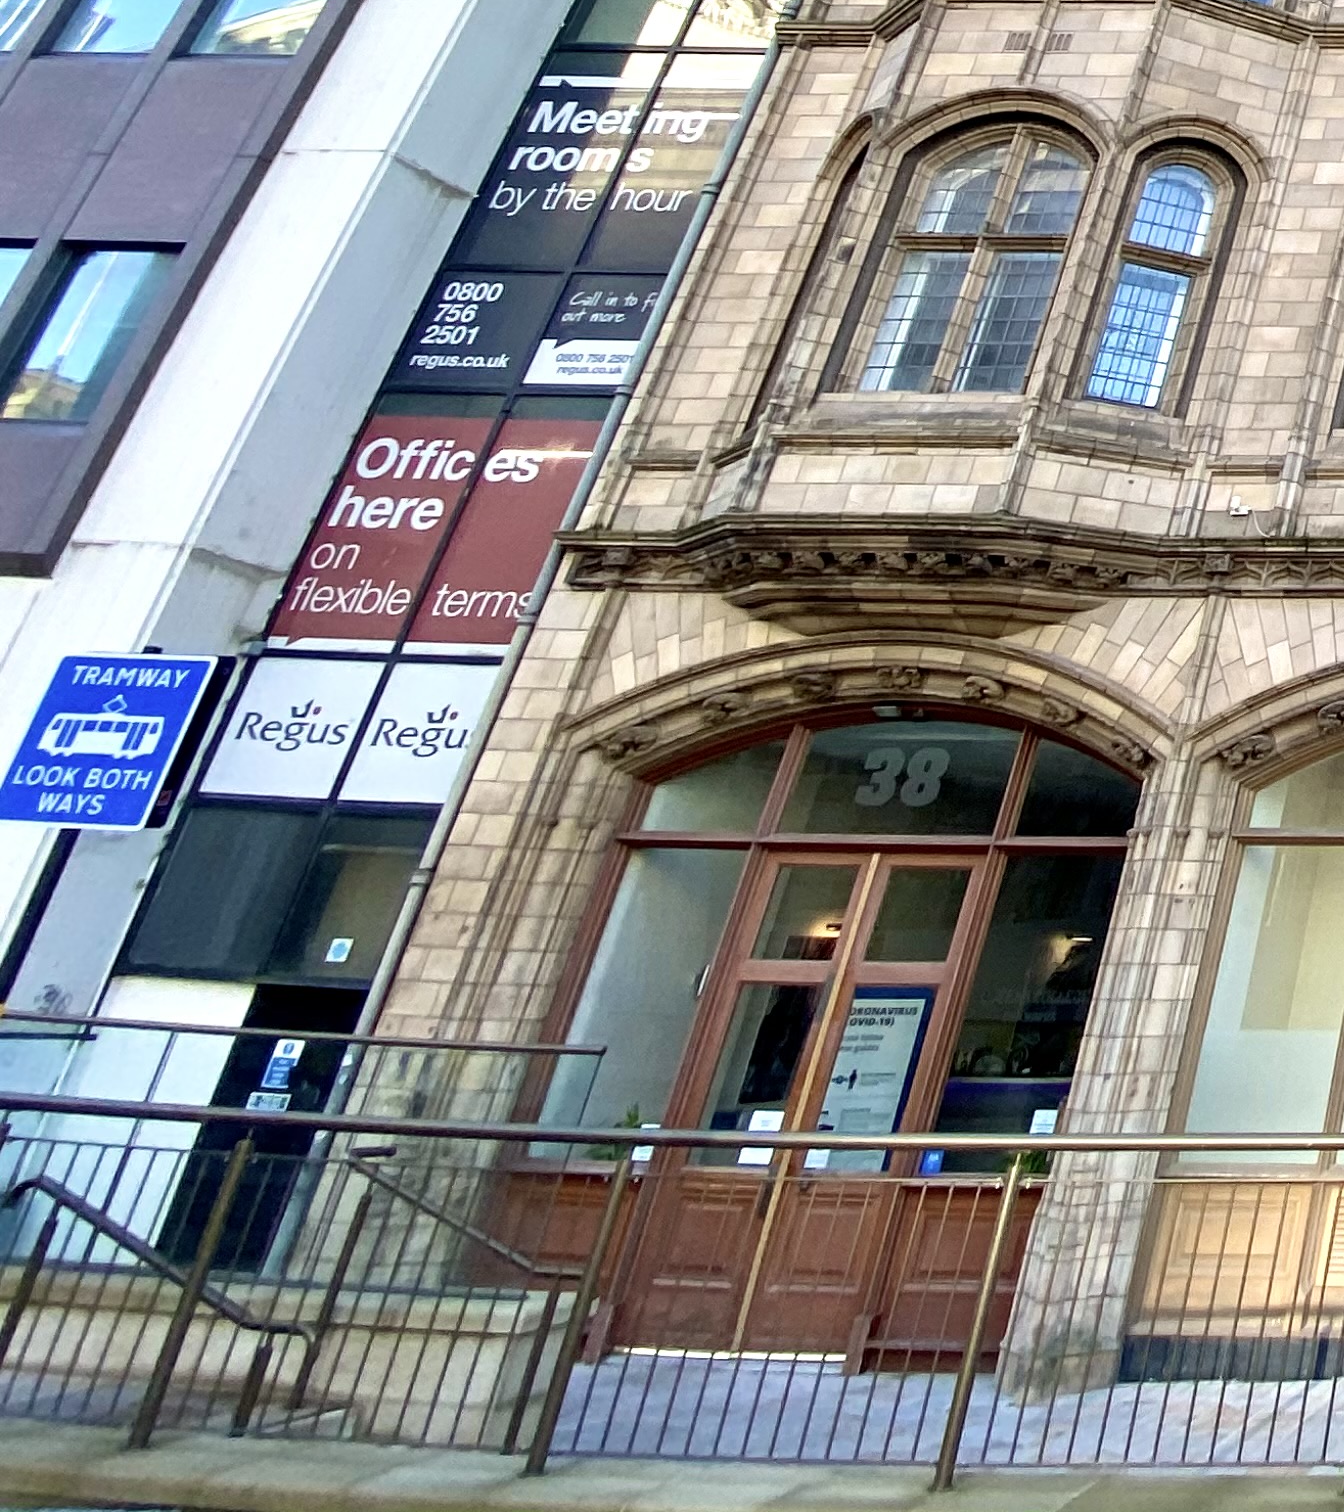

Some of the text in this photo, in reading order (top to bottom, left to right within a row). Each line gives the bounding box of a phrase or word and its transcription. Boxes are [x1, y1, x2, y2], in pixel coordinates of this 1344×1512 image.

[527, 101, 711, 143] Meeting
[508, 146, 655, 173] rooms
[488, 180, 695, 216] by the hour
[443, 281, 505, 302] 0800
[568, 291, 603, 306] Call
[605, 291, 618, 307] in
[624, 292, 639, 307] to
[433, 304, 479, 323] 756
[561, 308, 627, 323] out more
[420, 325, 481, 345] 2501
[409, 353, 511, 370] regus.co.uk
[556, 353, 584, 363] 0800
[586, 353, 606, 363] 756
[557, 365, 623, 376] regus.co.uk
[356, 437, 544, 483] Offices
[327, 485, 445, 531] here
[310, 543, 361, 569] on
[290, 577, 411, 615] flexible
[72, 665, 190, 688] TRAMWAY
[234, 710, 472, 758] Regus Regu
[12, 765, 153, 790] LOOK BOTH
[855, 747, 951, 807] 38
[37, 791, 106, 815] WAYS
[849, 1007, 918, 1016] ORONAVIRUS
